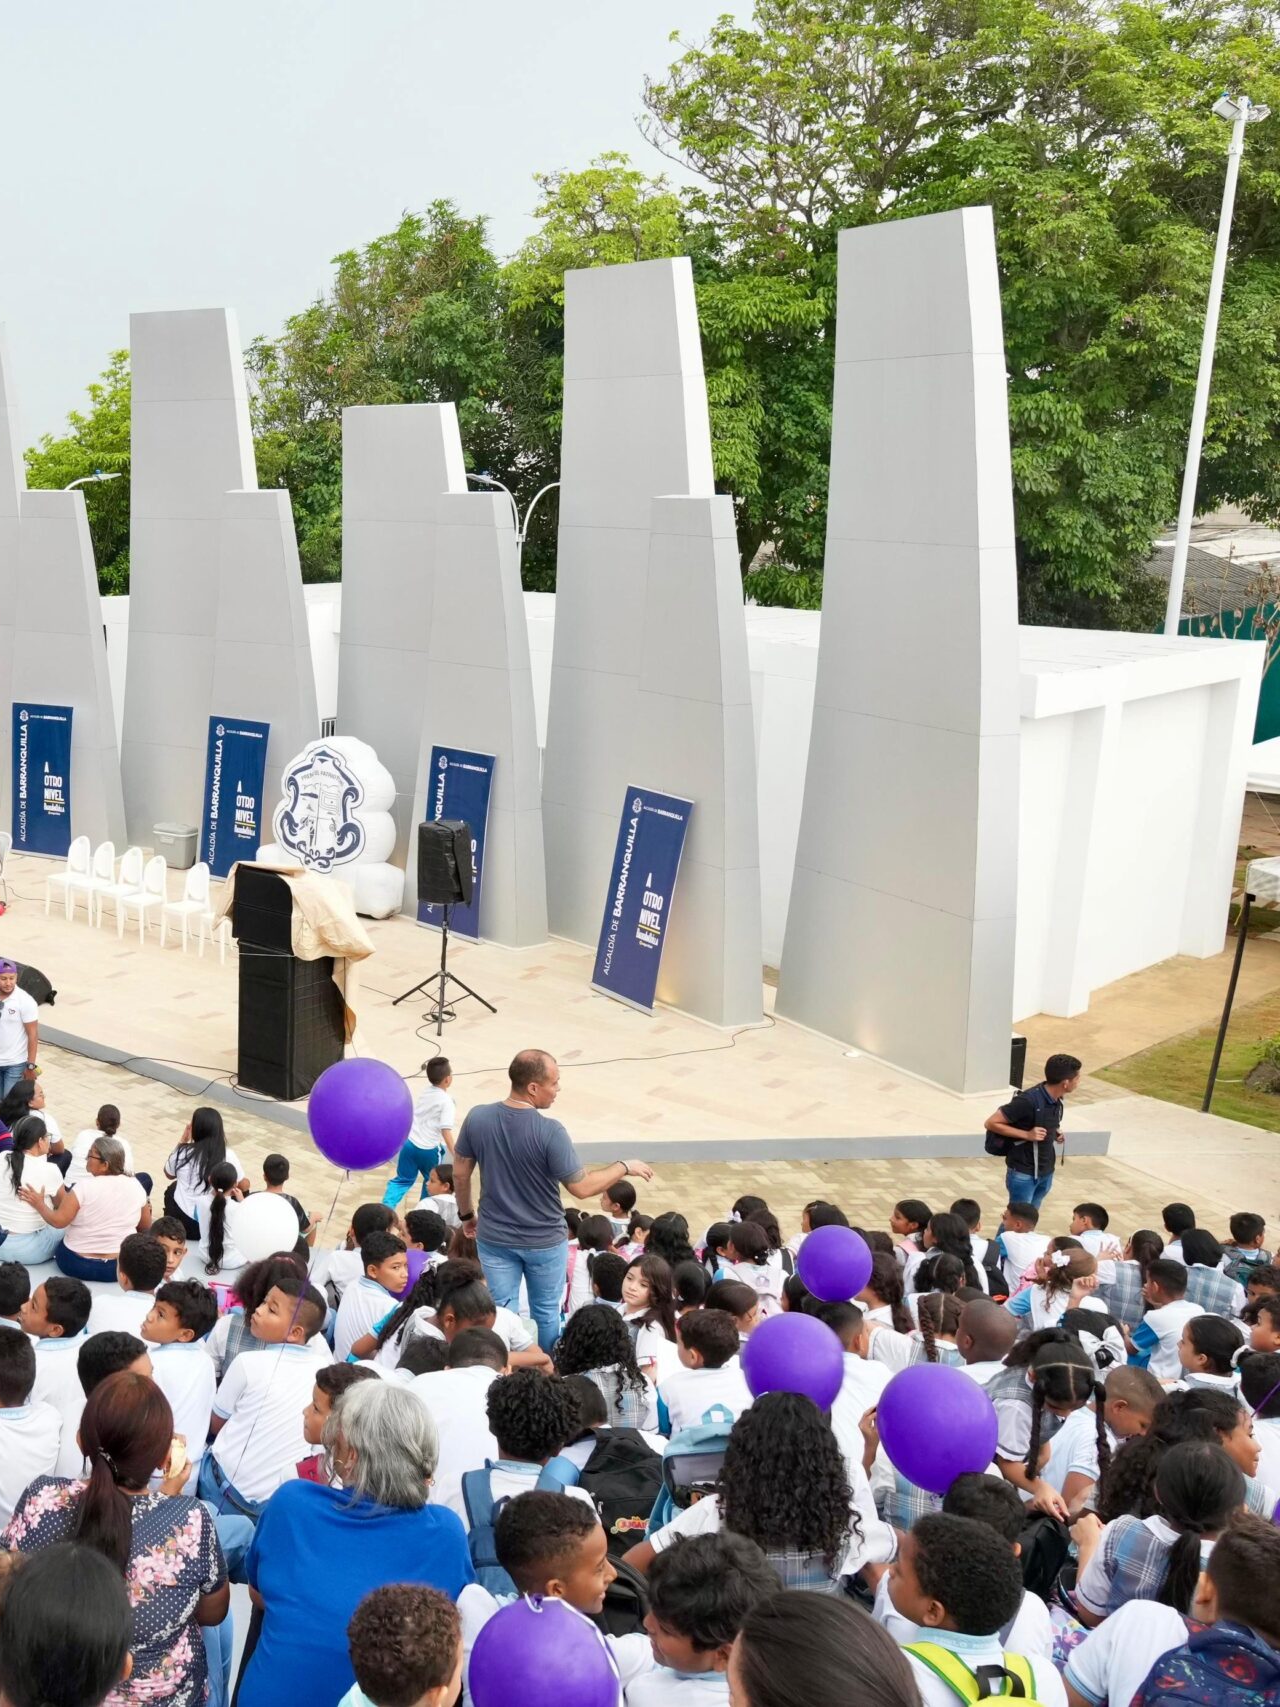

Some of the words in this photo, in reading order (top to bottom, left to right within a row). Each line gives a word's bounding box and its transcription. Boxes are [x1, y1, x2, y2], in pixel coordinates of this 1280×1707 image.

[19, 724, 28, 799] BARRANQUILLA
[44, 761, 49, 773] A
[44, 775, 62, 788] OTRO
[210, 740, 223, 819] BARRANQUILLA
[237, 780, 242, 792] A
[44, 788, 64, 801] NIVEL
[236, 795, 255, 810] OTRO
[435, 773, 446, 821] NQUILLA
[235, 809, 256, 824] NIVEL
[208, 831, 216, 866] ALCALDÍA
[613, 818, 639, 918] BARRANQUILLA
[646, 873, 652, 887] A
[643, 891, 664, 911] OTRO
[611, 919, 619, 931] DE
[639, 908, 661, 931] NIVEL
[603, 933, 617, 976] ALCALDÍA
